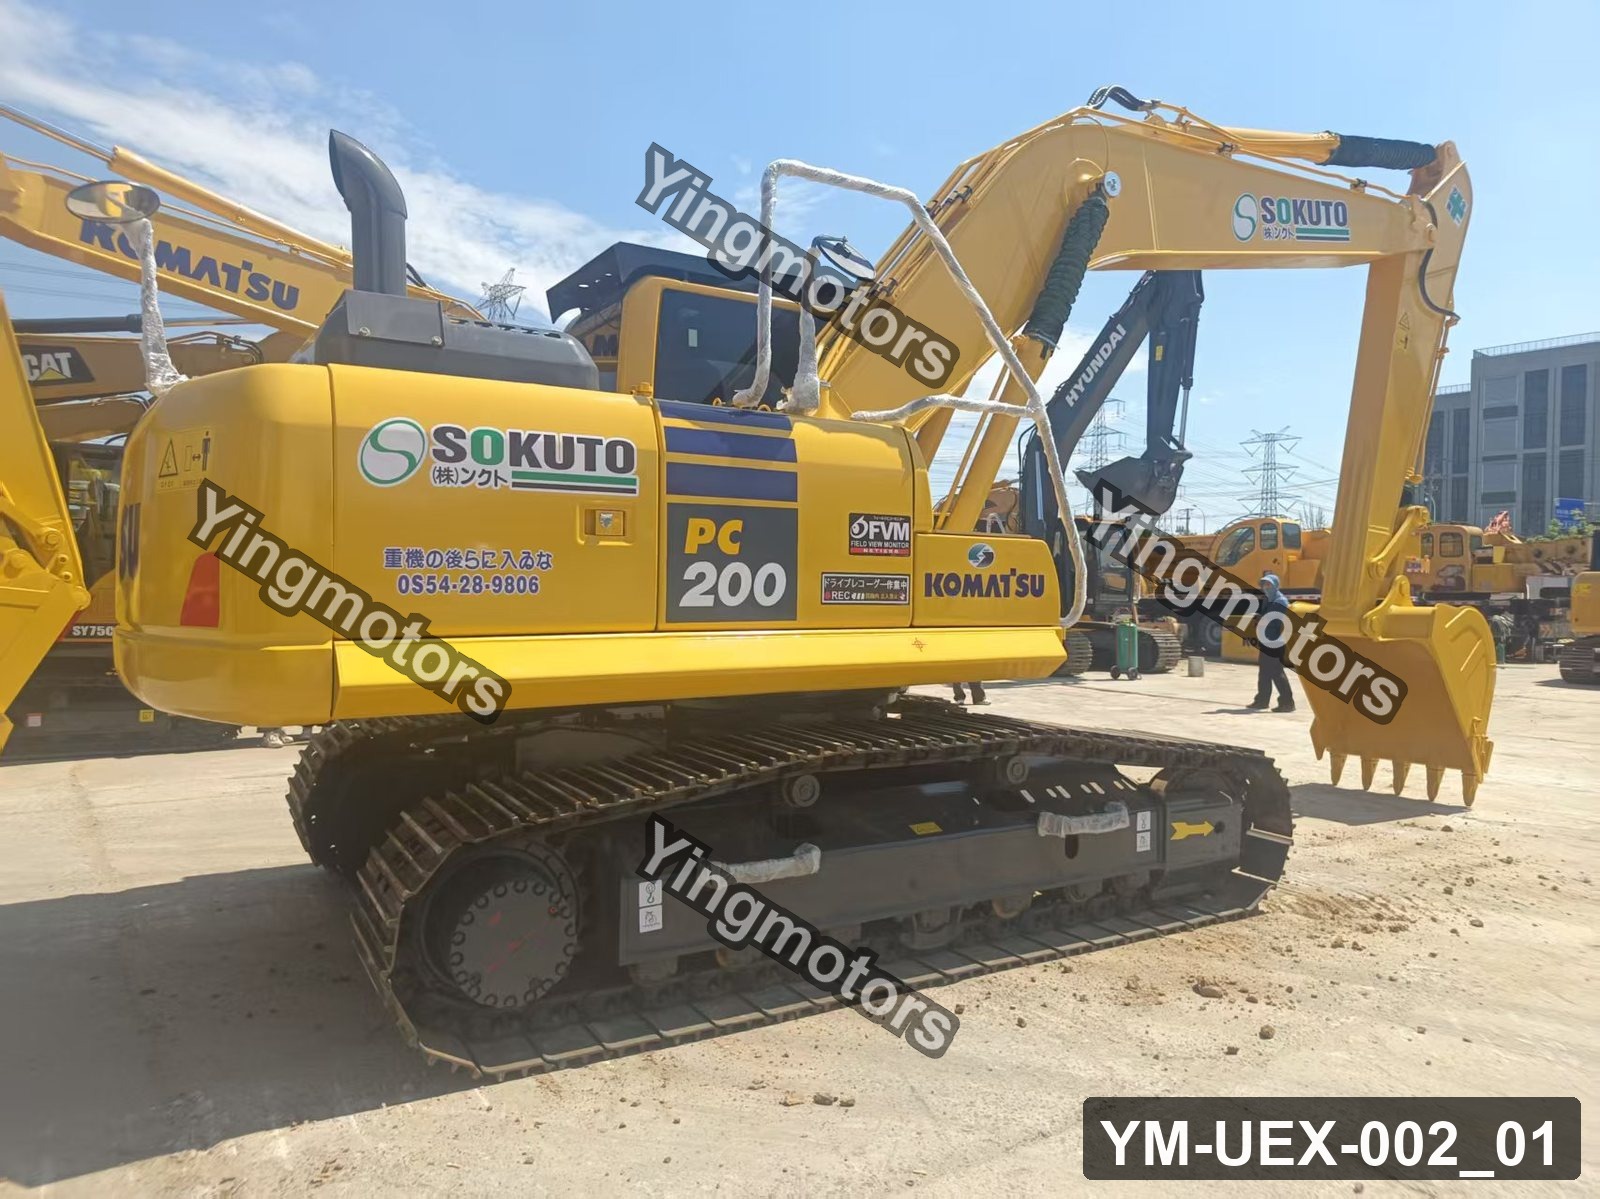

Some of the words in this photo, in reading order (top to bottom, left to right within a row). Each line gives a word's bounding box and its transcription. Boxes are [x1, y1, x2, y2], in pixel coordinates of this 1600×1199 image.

[1260, 197, 1348, 227] SOKUTO
[23, 352, 73, 381] CAT
[1065, 323, 1127, 408] HYUNDAI
[431, 425, 635, 474] SOKUTO
[684, 518, 743, 554] PC
[850, 540, 868, 548] FIELD
[884, 541, 910, 549] MONITOR
[868, 520, 910, 541] FVM
[679, 561, 787, 607] 200
[831, 591, 851, 600] REC
[924, 568, 1045, 598] KOMATSU
